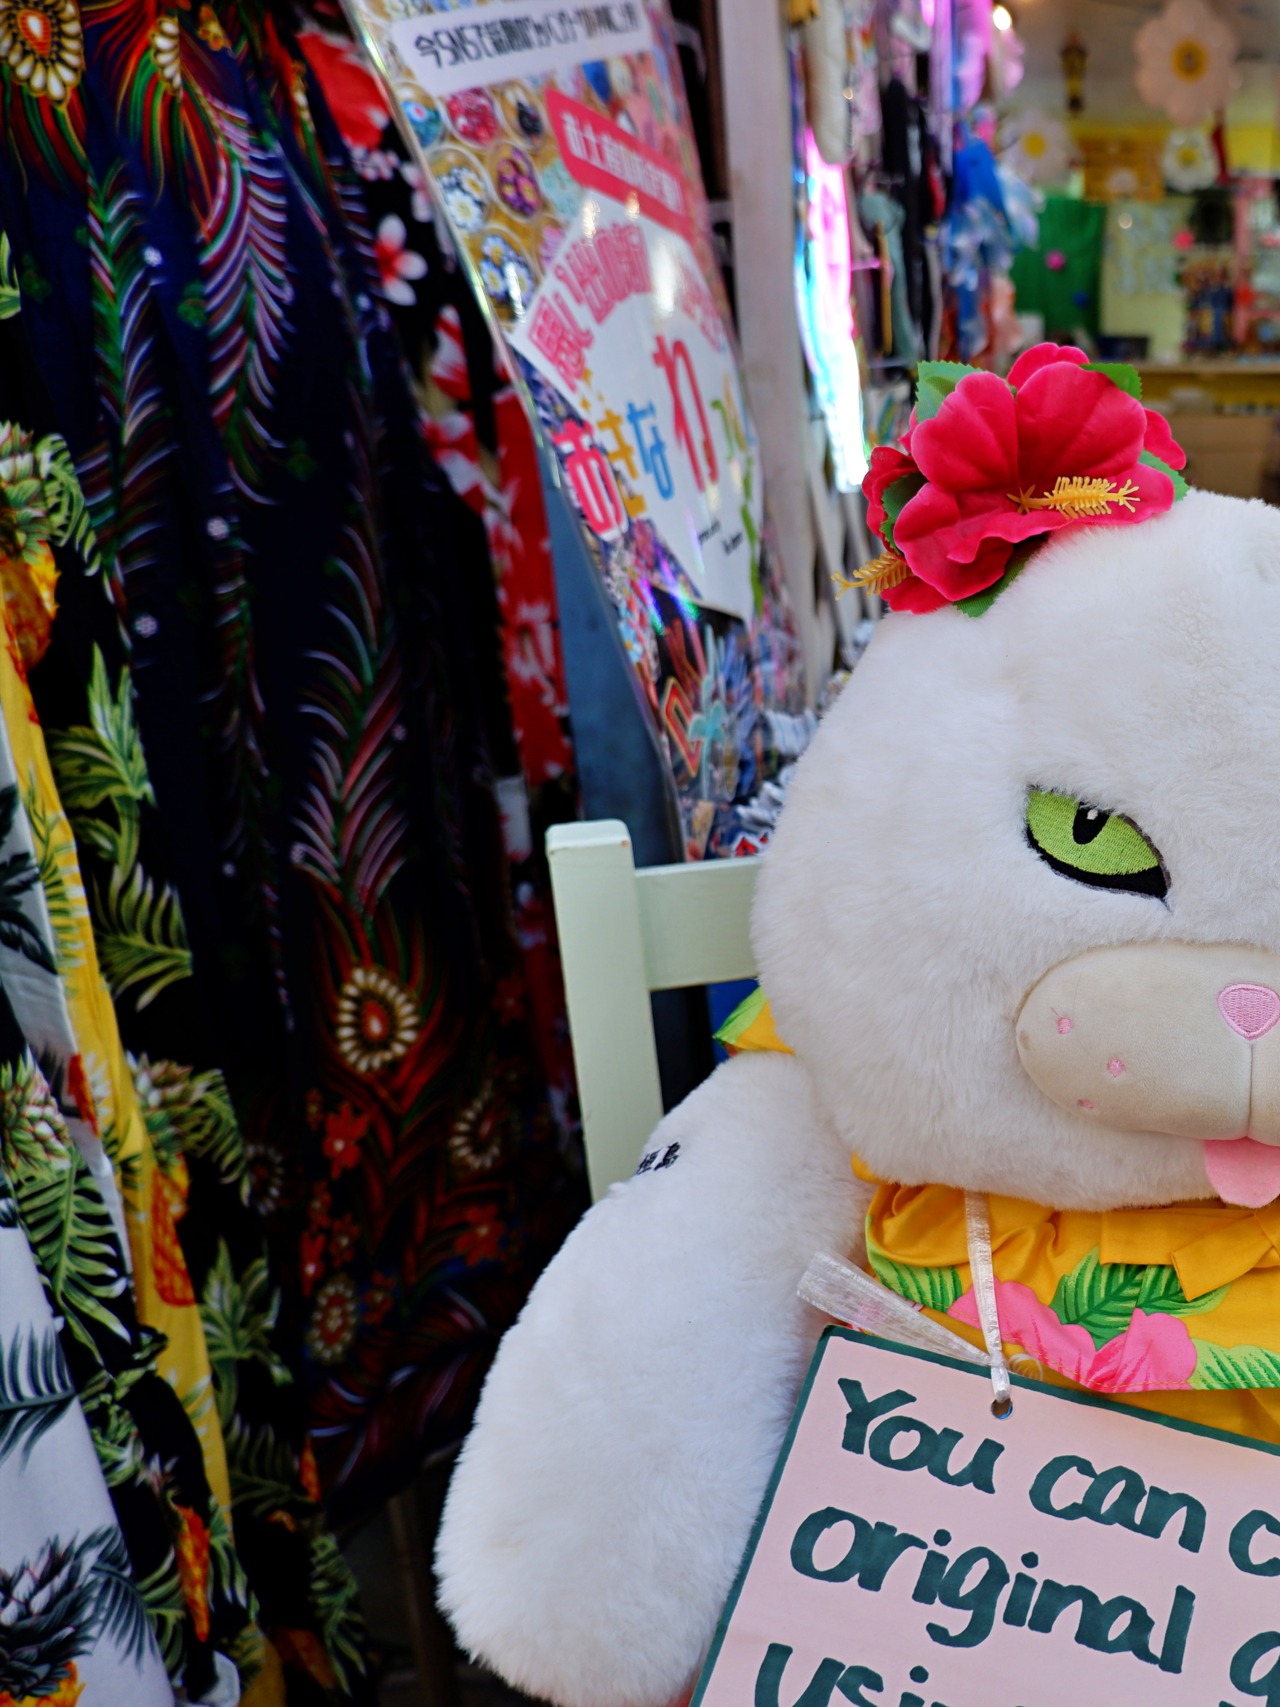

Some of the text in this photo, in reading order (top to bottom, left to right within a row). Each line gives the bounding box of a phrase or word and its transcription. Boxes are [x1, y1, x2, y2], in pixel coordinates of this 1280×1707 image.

[838, 1377, 1005, 1494] You
[1029, 1455, 1207, 1553] can
[790, 1506, 1196, 1674] original
